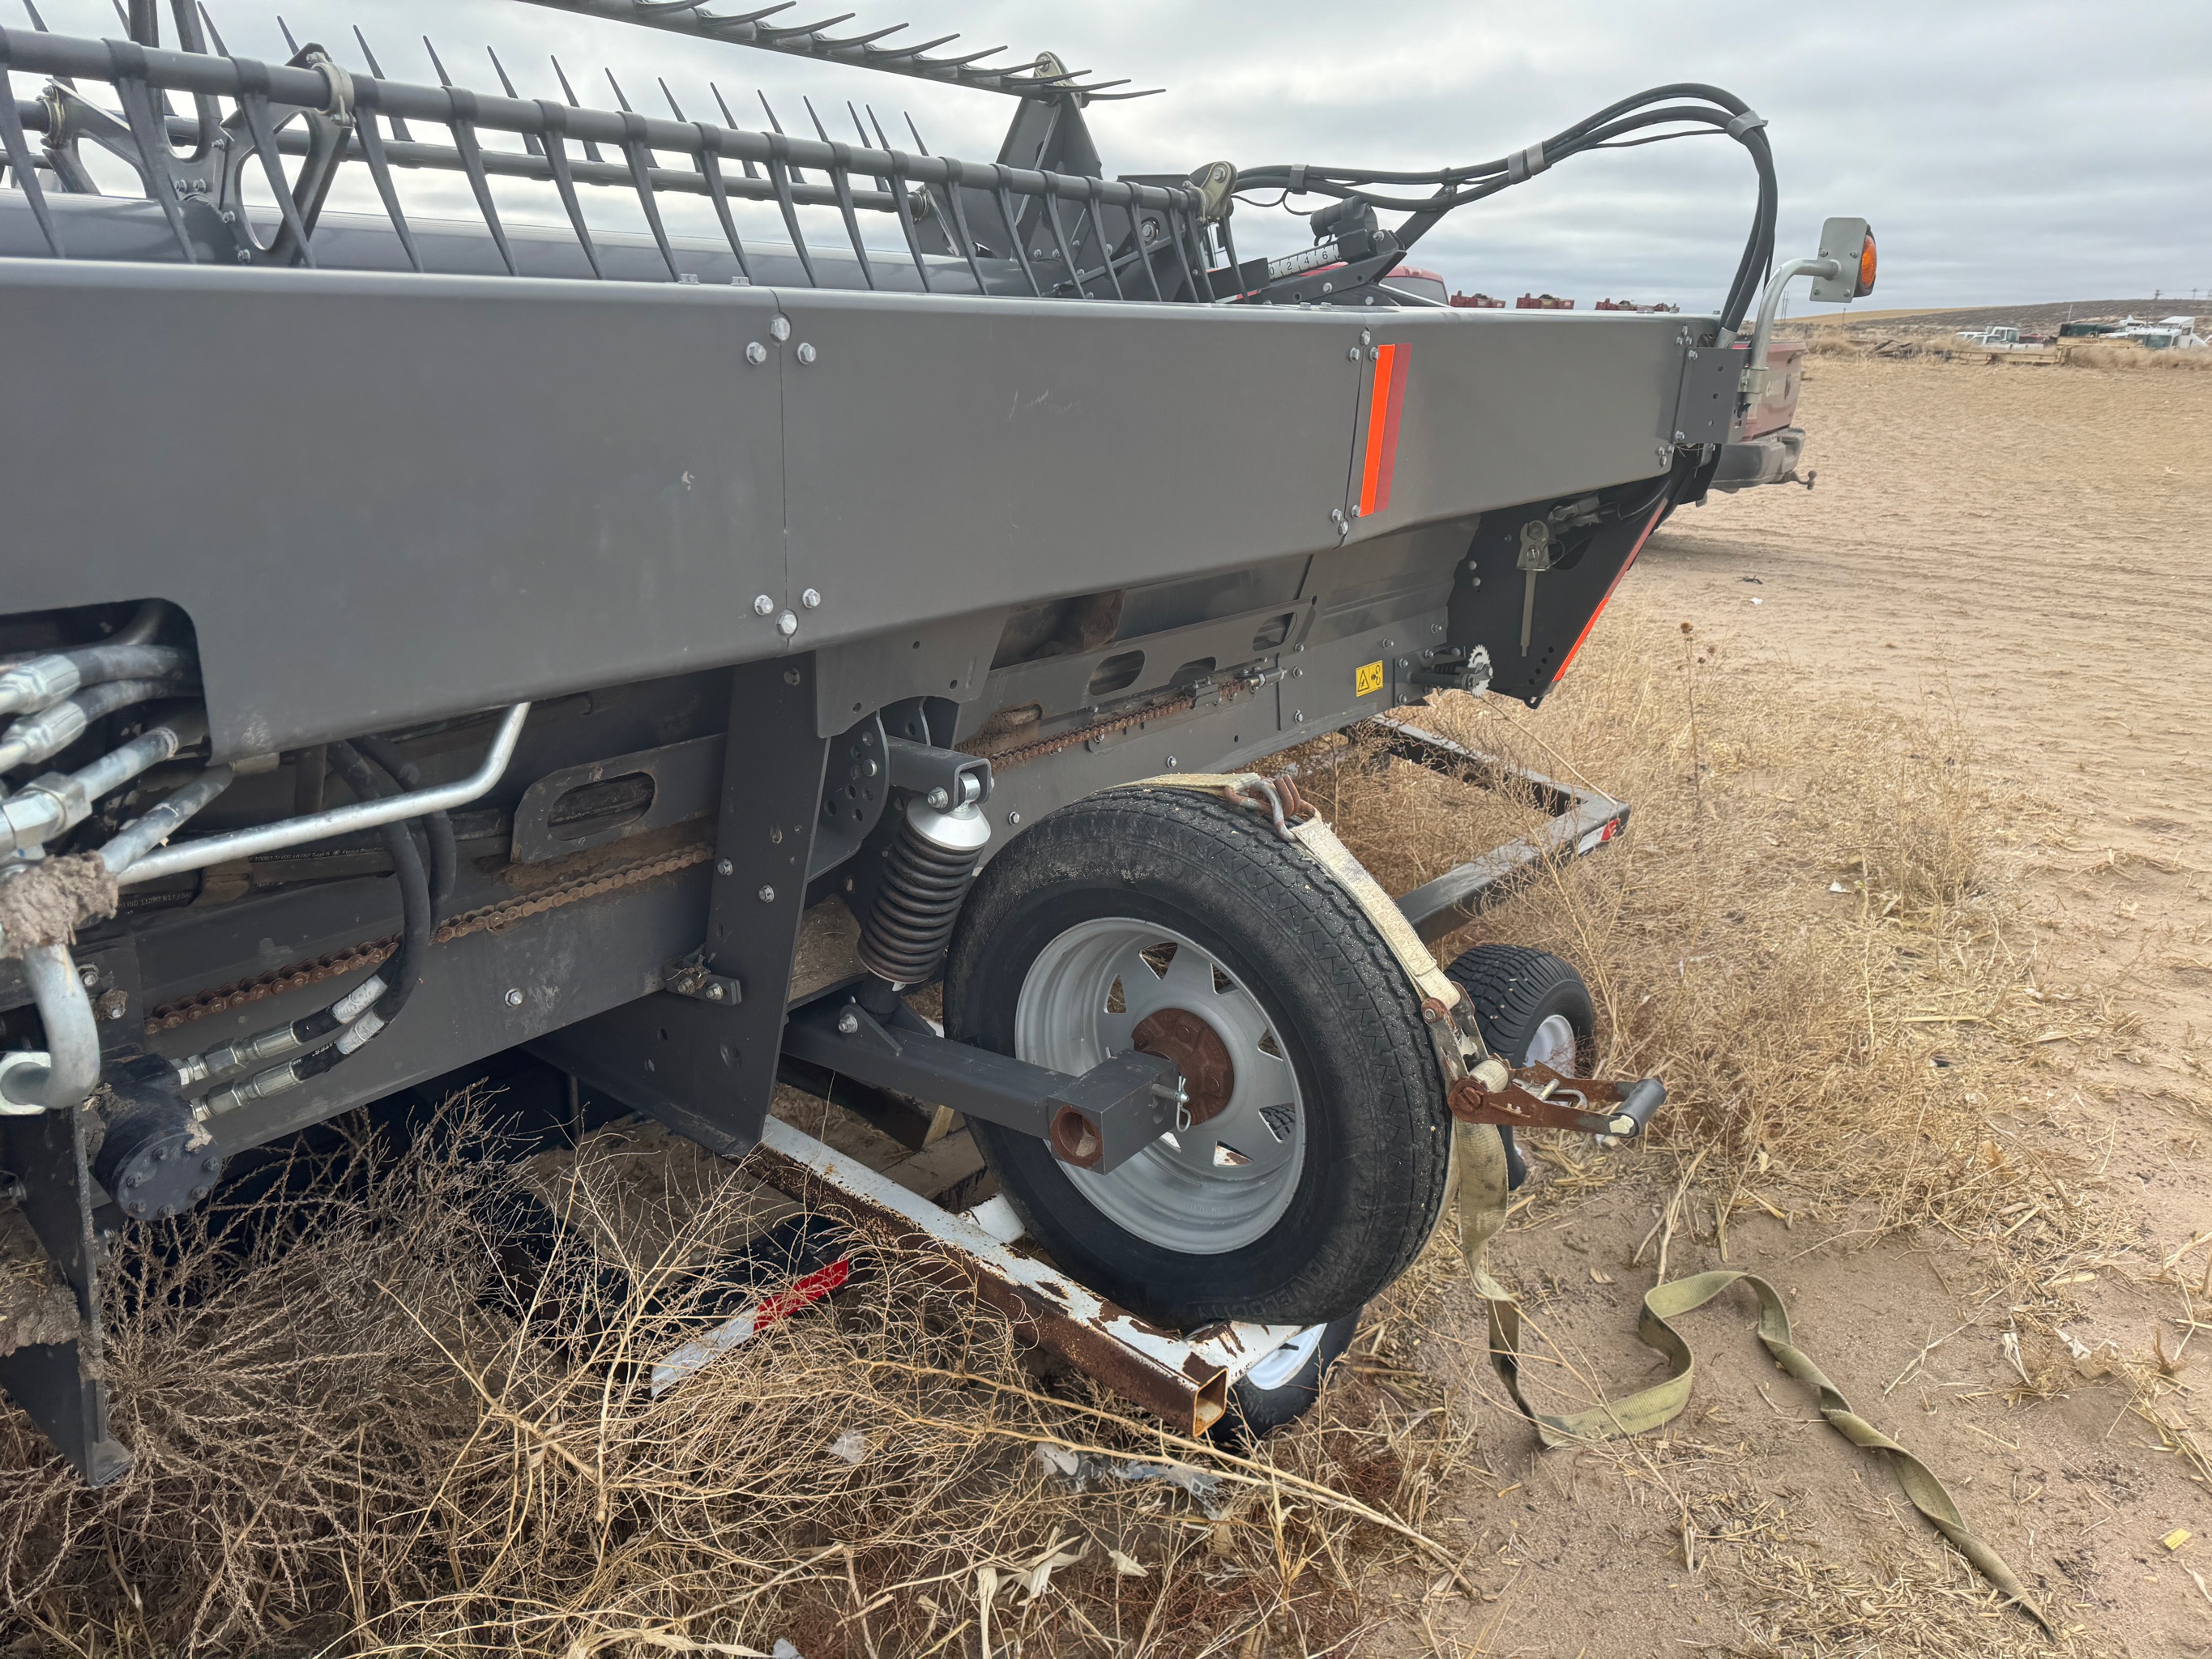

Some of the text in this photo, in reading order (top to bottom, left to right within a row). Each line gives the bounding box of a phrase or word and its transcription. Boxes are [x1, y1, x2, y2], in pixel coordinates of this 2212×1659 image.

[1269, 251, 1328, 275] 0 2 4 6
